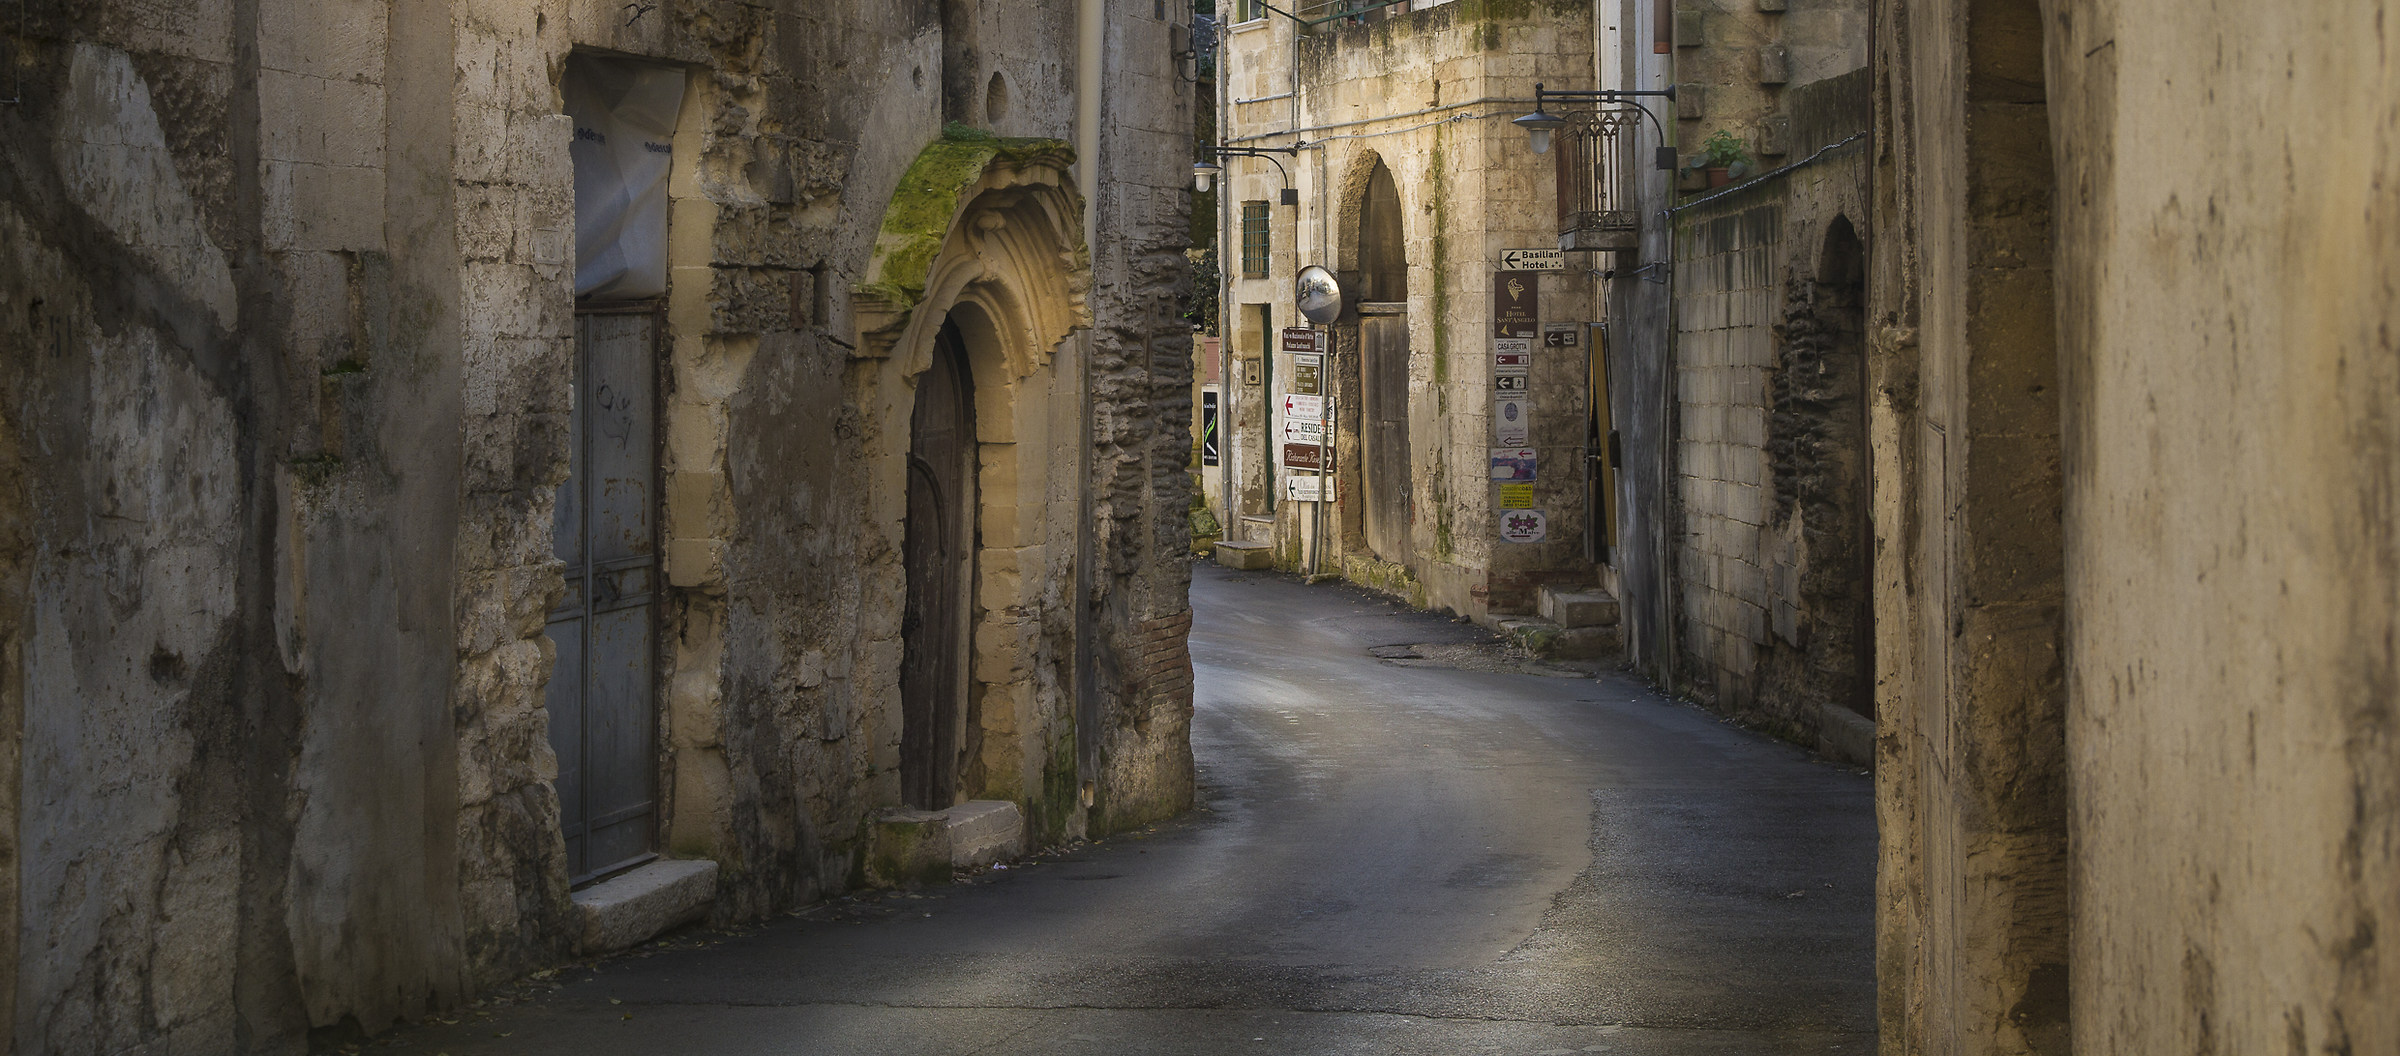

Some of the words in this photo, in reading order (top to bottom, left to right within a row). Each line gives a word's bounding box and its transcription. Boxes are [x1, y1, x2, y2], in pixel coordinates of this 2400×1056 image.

[1522, 250, 1563, 259] Basiliani
[1522, 261, 1549, 269] Hotel
[1497, 342, 1510, 350] CASA
[1510, 342, 1527, 351] GROTTA
[1301, 422, 1333, 436] RESIDEE
